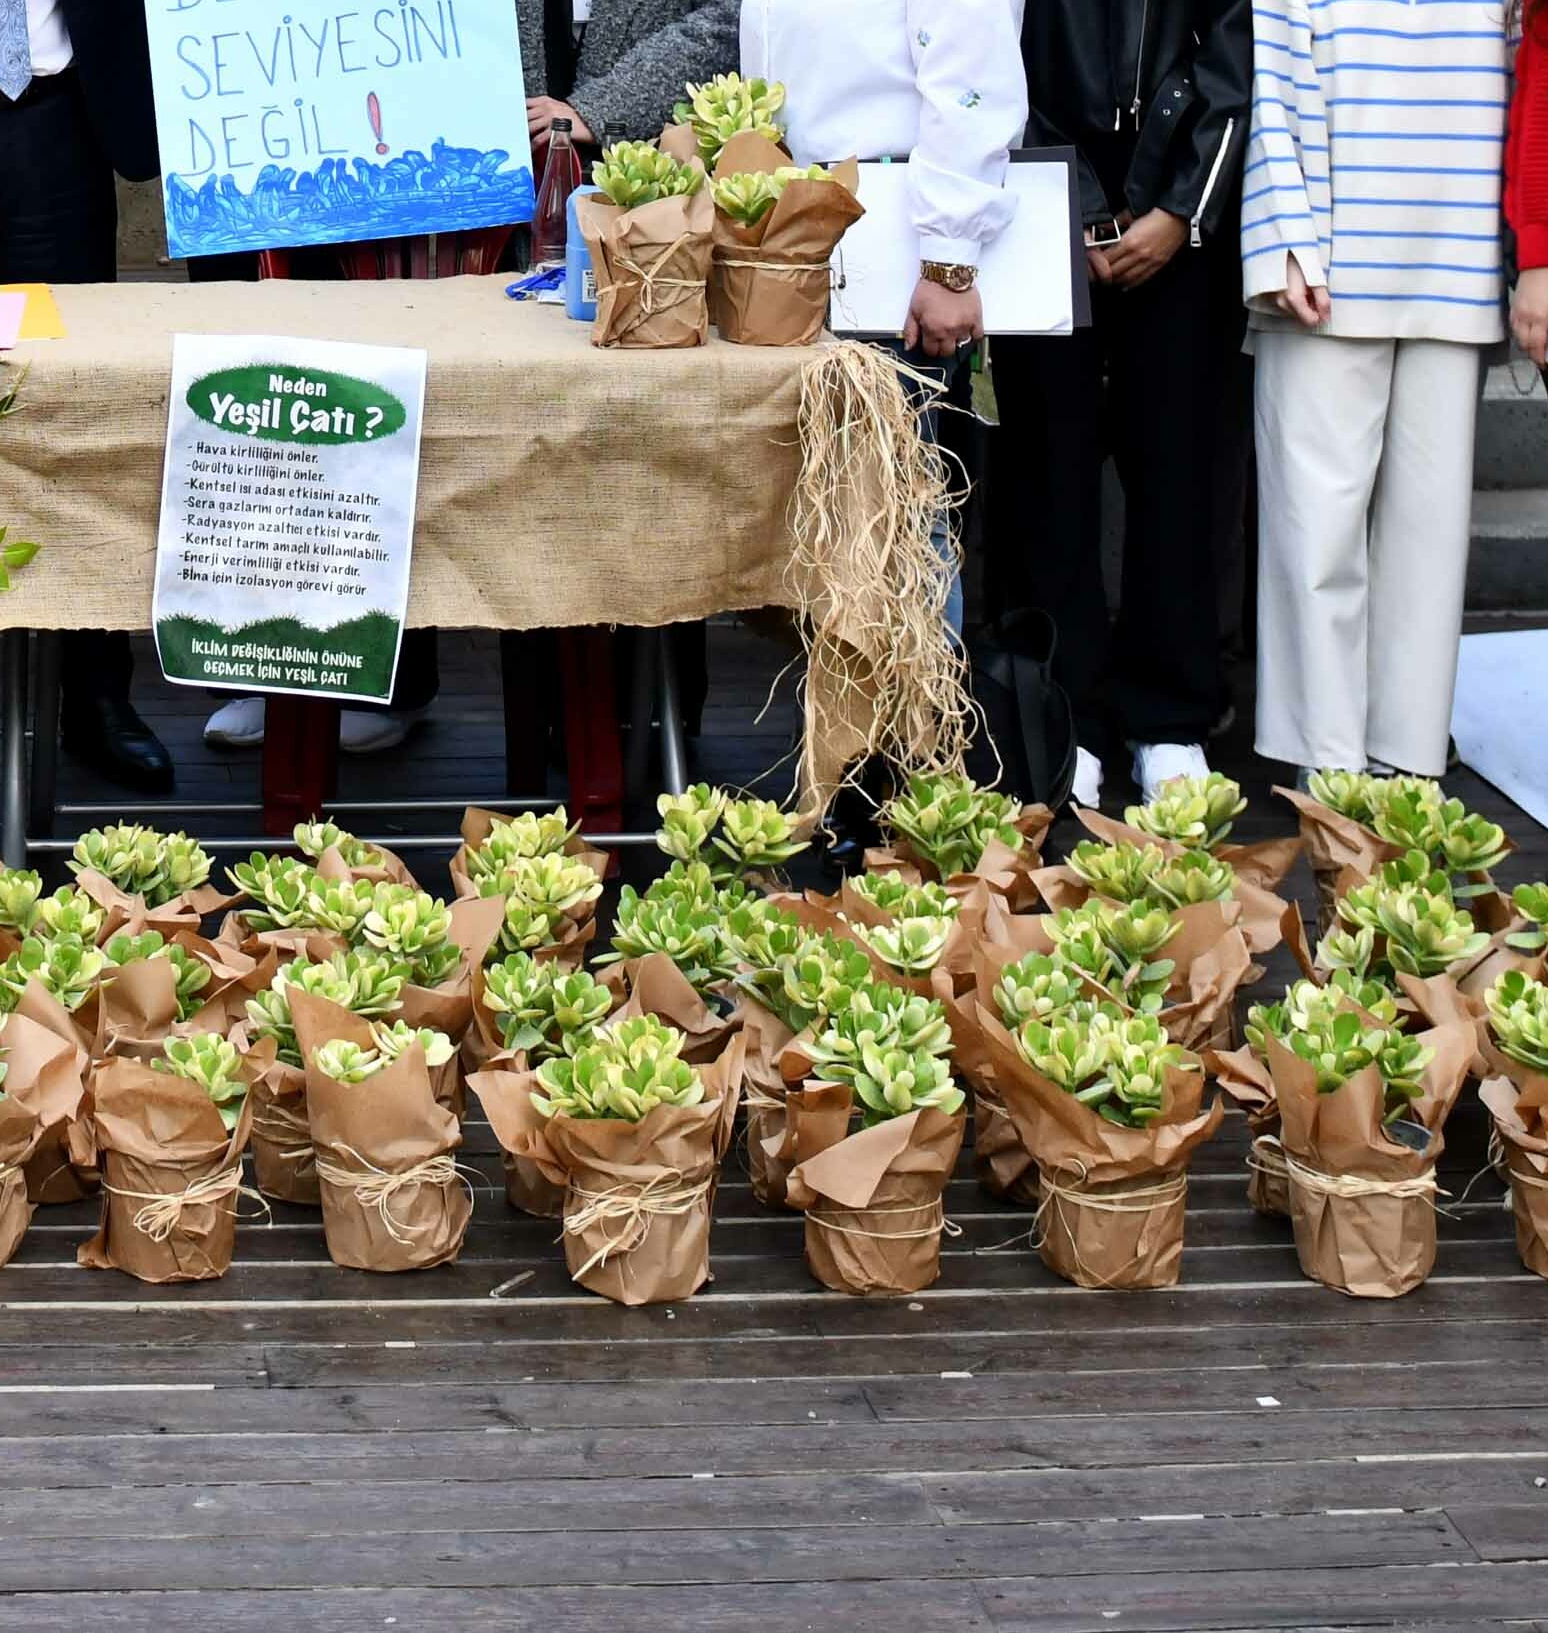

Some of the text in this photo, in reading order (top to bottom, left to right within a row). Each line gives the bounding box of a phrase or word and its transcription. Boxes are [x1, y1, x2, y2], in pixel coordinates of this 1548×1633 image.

[269, 374, 327, 397] Neden
[209, 392, 282, 435] Yeşil
[290, 400, 355, 436] Çatı
[196, 441, 227, 455] Hava
[230, 445, 284, 462] kirliliğini
[236, 463, 291, 480] kirliliğini
[288, 486, 335, 502] etkisini
[219, 500, 272, 514] gazlarını
[275, 504, 325, 518] ortadan
[306, 524, 340, 538] etkisi
[286, 559, 320, 573] etkisi
[236, 573, 293, 590] izolasyon
[337, 583, 367, 596] görür
[191, 638, 228, 657] İKLİM
[321, 650, 363, 668] ÖNÜNE
[203, 660, 348, 686] GEÇMEK İÇİN YEŞİL ÇATI
